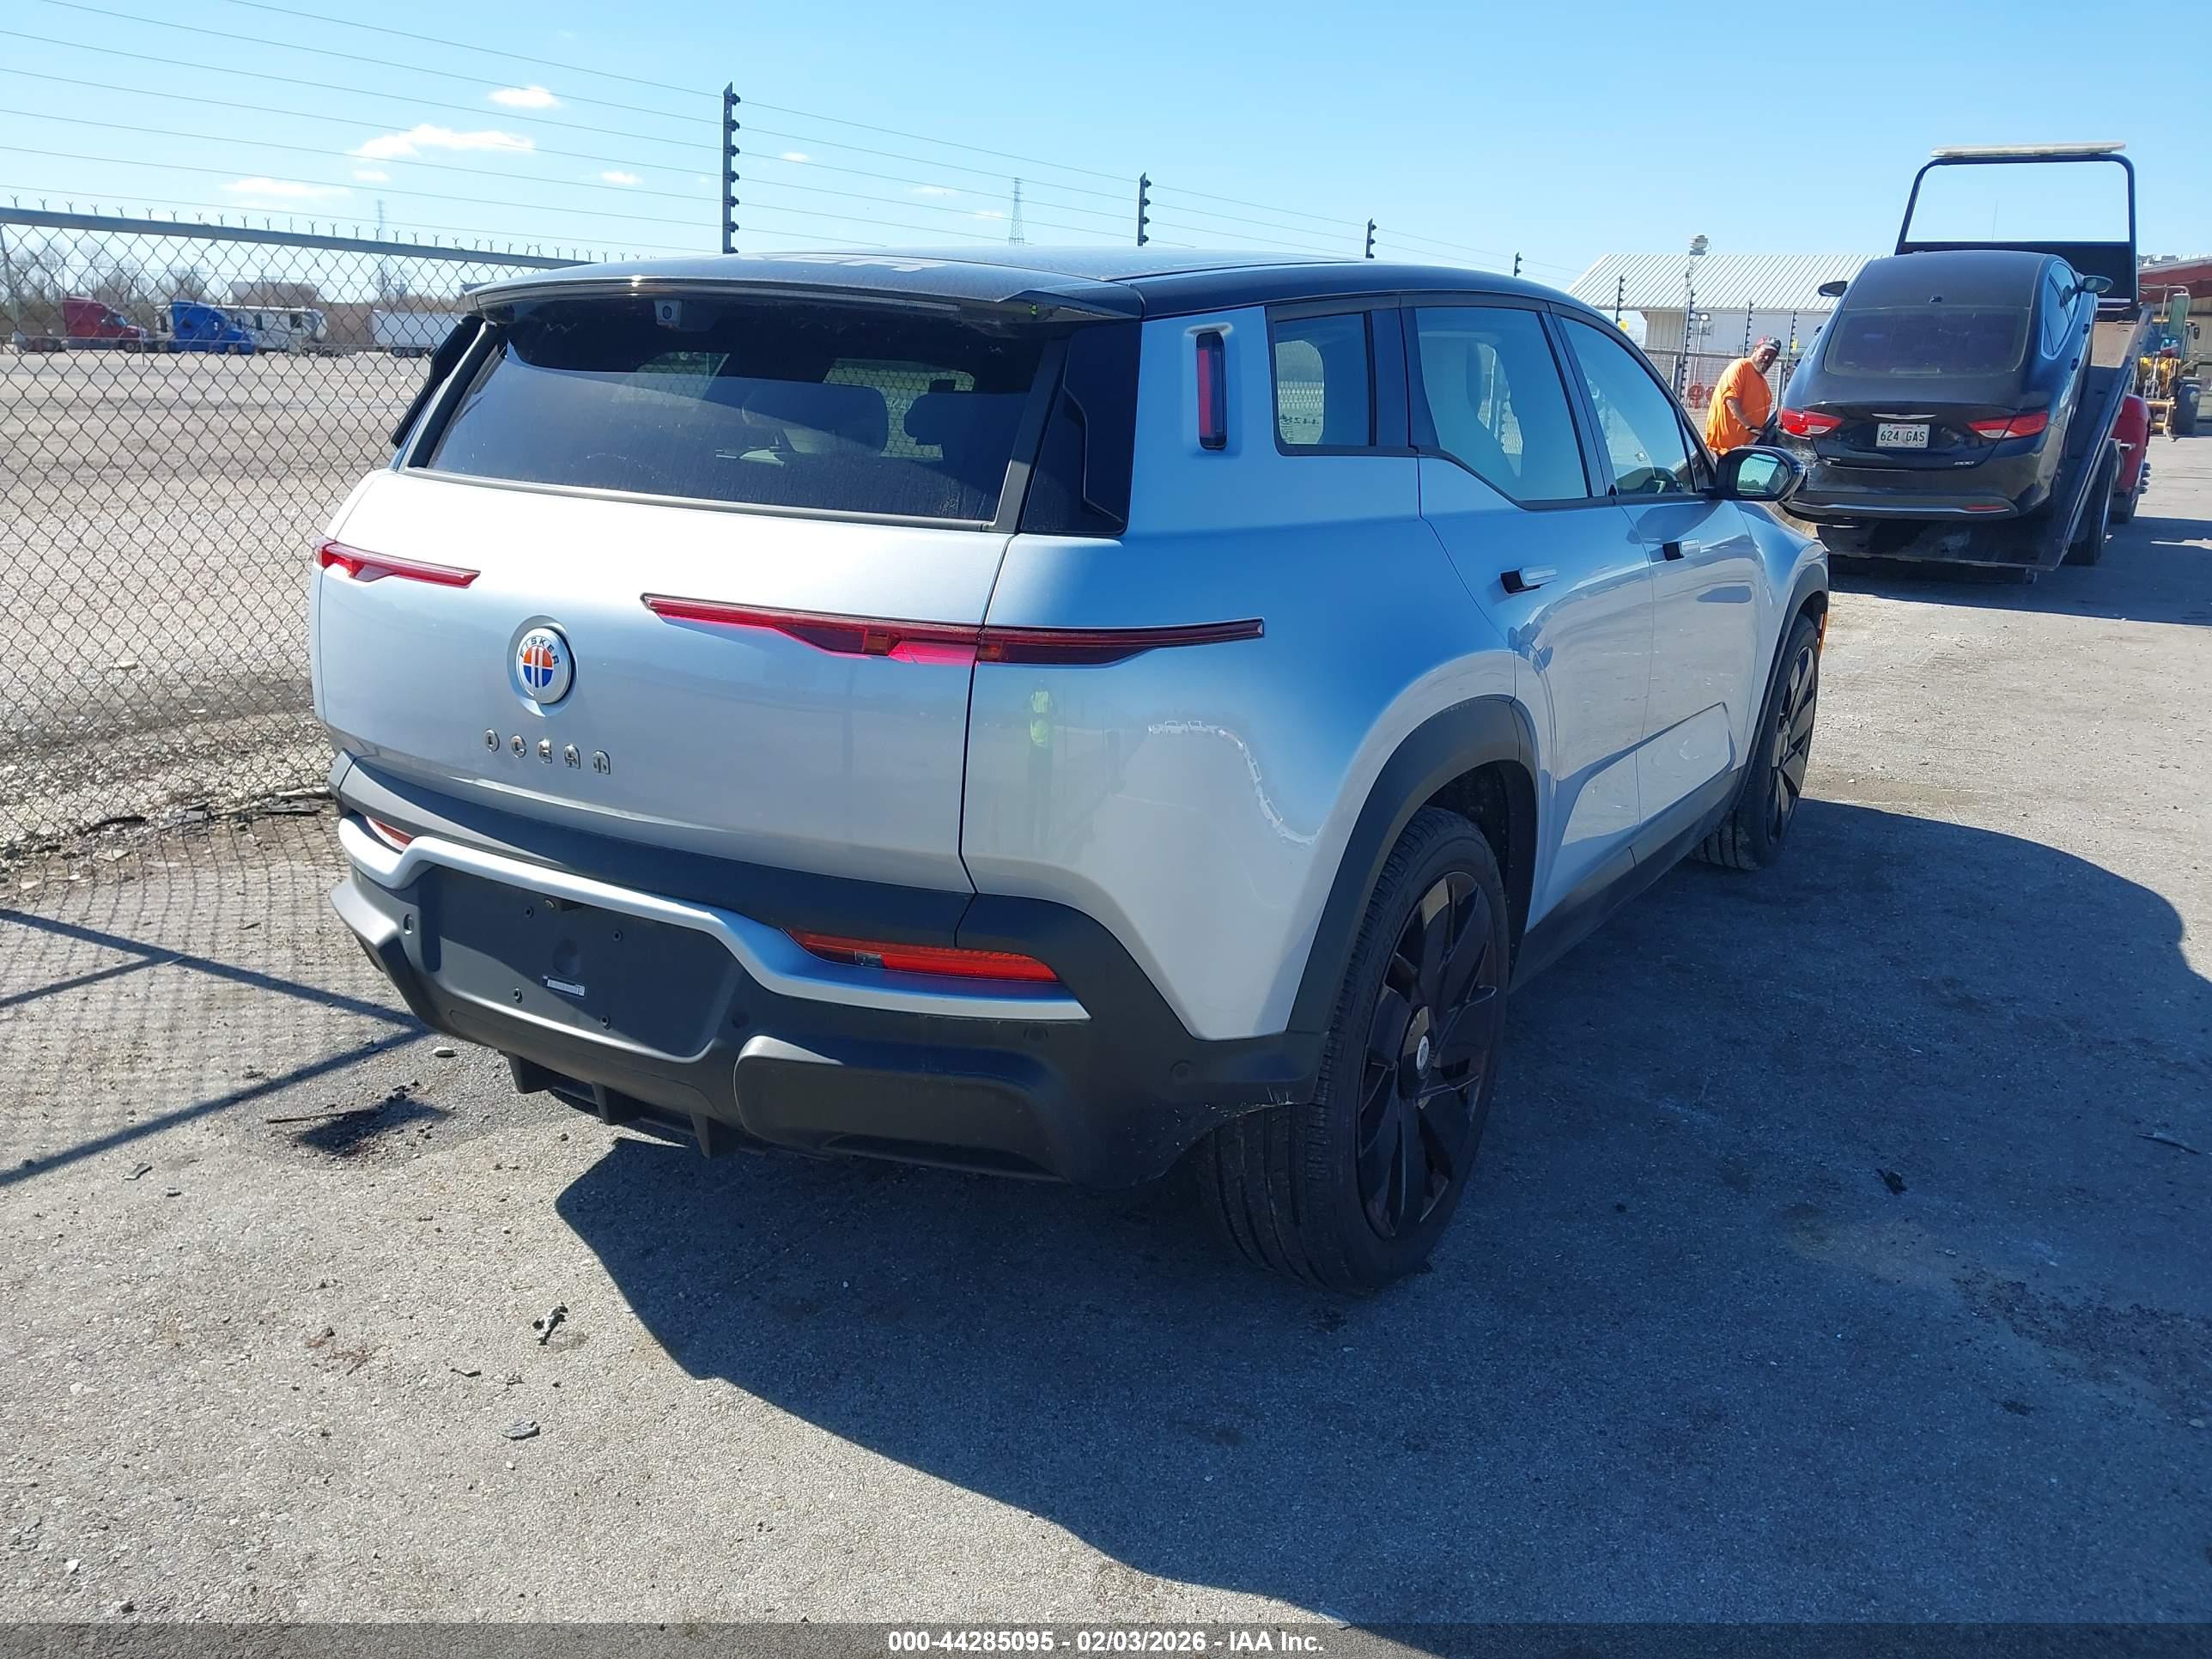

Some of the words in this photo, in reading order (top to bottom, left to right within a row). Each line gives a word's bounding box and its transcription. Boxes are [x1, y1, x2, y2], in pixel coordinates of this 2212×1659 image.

[1880, 430, 1899, 442] 624
[1905, 430, 1925, 442] GAS
[520, 636, 560, 665] FISKER
[484, 728, 611, 775] OCEAN
